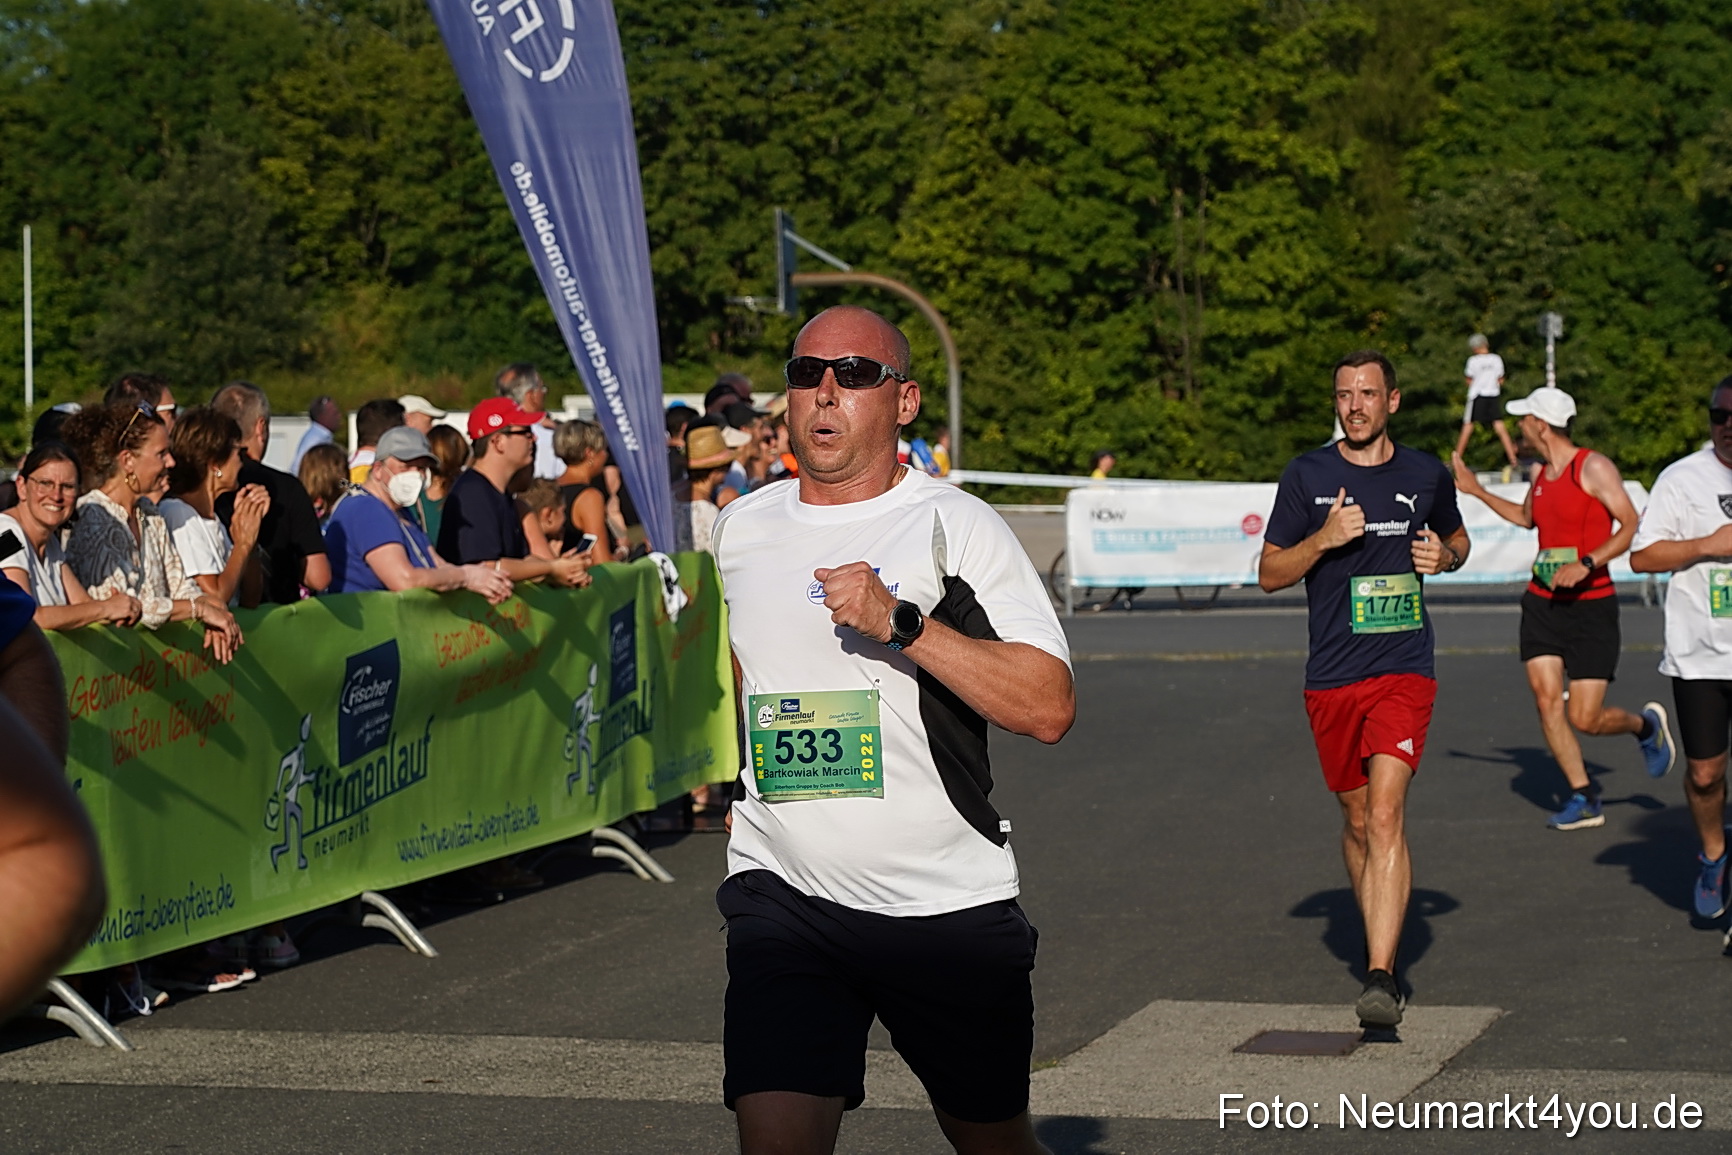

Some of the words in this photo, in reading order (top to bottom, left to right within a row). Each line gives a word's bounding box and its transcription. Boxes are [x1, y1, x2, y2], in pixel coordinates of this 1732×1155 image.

[1365, 520, 1410, 532] rmenlauf
[1366, 593, 1413, 614] 1775
[69, 647, 158, 721] Gesunde
[348, 679, 392, 707] Fischer
[775, 710, 815, 721] Firmenlauf
[110, 707, 162, 767] laufen
[774, 728, 844, 764] 533
[314, 714, 435, 830] firmenlauf
[755, 743, 765, 780] RUN
[763, 768, 819, 779] Bartkowiak
[822, 765, 861, 777] Marcin
[860, 732, 875, 782] 2022
[313, 814, 370, 858] neumarkt
